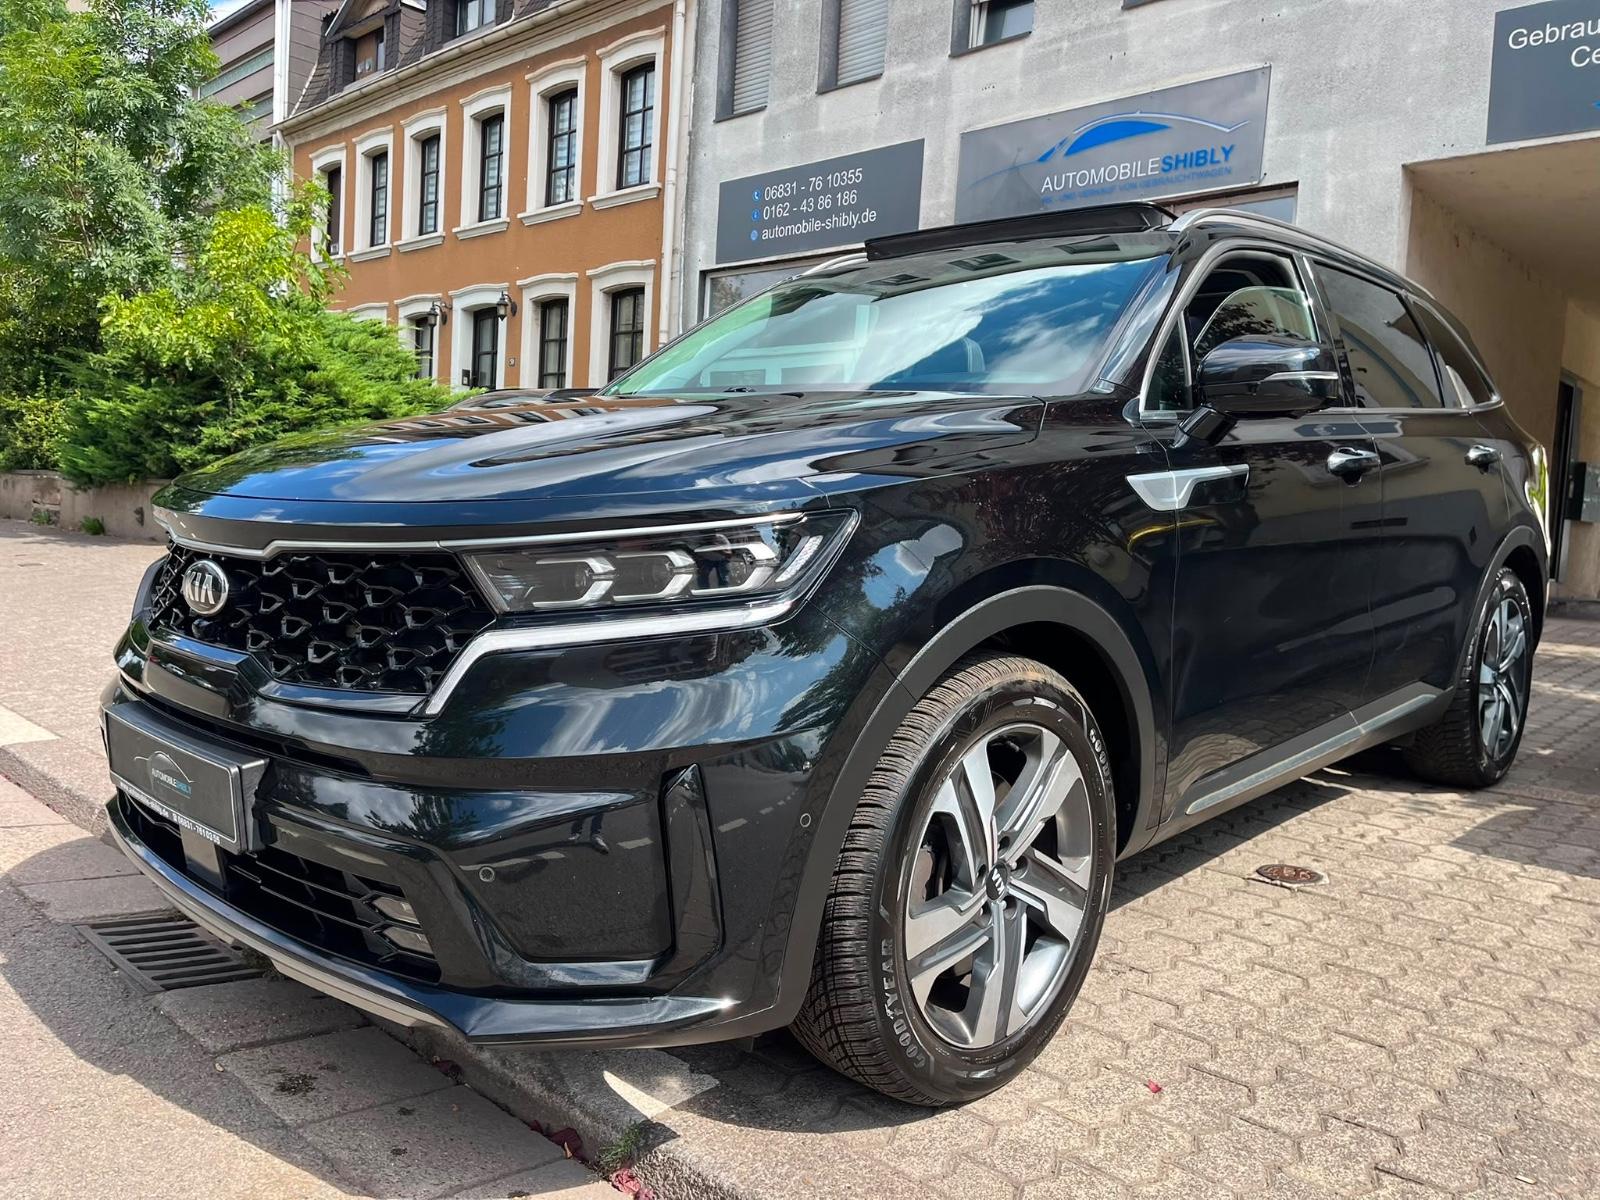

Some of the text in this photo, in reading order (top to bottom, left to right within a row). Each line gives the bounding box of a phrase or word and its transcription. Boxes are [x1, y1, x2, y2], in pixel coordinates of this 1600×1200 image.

[764, 181, 797, 201] 06831
[808, 176, 823, 193] 76
[826, 167, 863, 189] 10355
[1040, 144, 1235, 193] AUTOMOBILESHIBLY
[763, 202, 790, 220] 0162
[800, 197, 815, 213] 43
[817, 194, 832, 210] 86
[836, 189, 858, 206] 186
[761, 207, 877, 240] automobile-shibly.de
